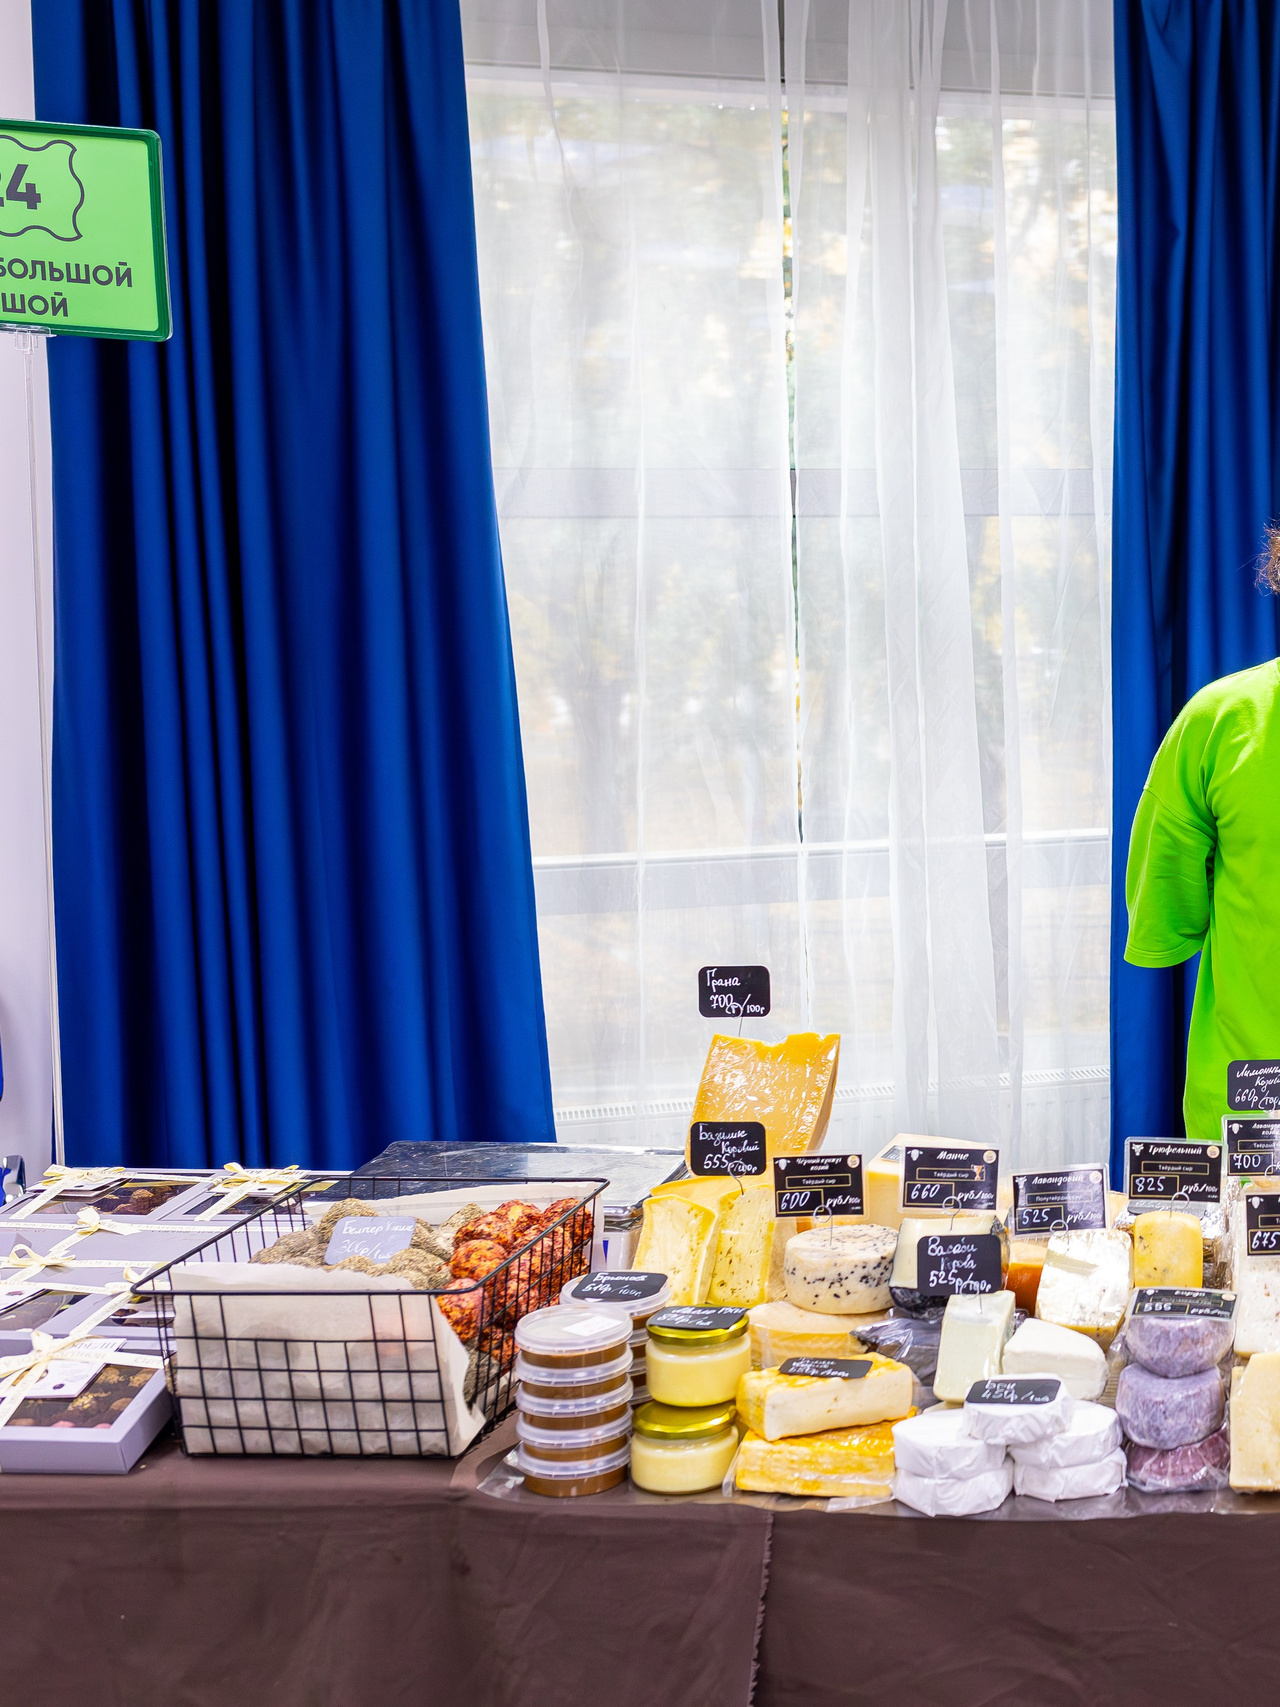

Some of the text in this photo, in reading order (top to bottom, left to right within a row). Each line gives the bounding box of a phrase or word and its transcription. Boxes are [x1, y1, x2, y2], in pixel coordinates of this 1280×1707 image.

[0, 163, 42, 211] 4
[0, 257, 133, 288] ОЛЬШОЙ
[0, 290, 69, 318] ШОЙ
[706, 967, 741, 993] Грана
[936, 1150, 970, 1161] Манче
[1148, 1144, 1203, 1156] Трюфельный
[1232, 1153, 1261, 1170] 700
[910, 1183, 941, 1200] 660
[1135, 1176, 1167, 1193] 825
[780, 1191, 811, 1211] 600
[1022, 1208, 1051, 1226] 525
[1251, 1230, 1280, 1249] 675
